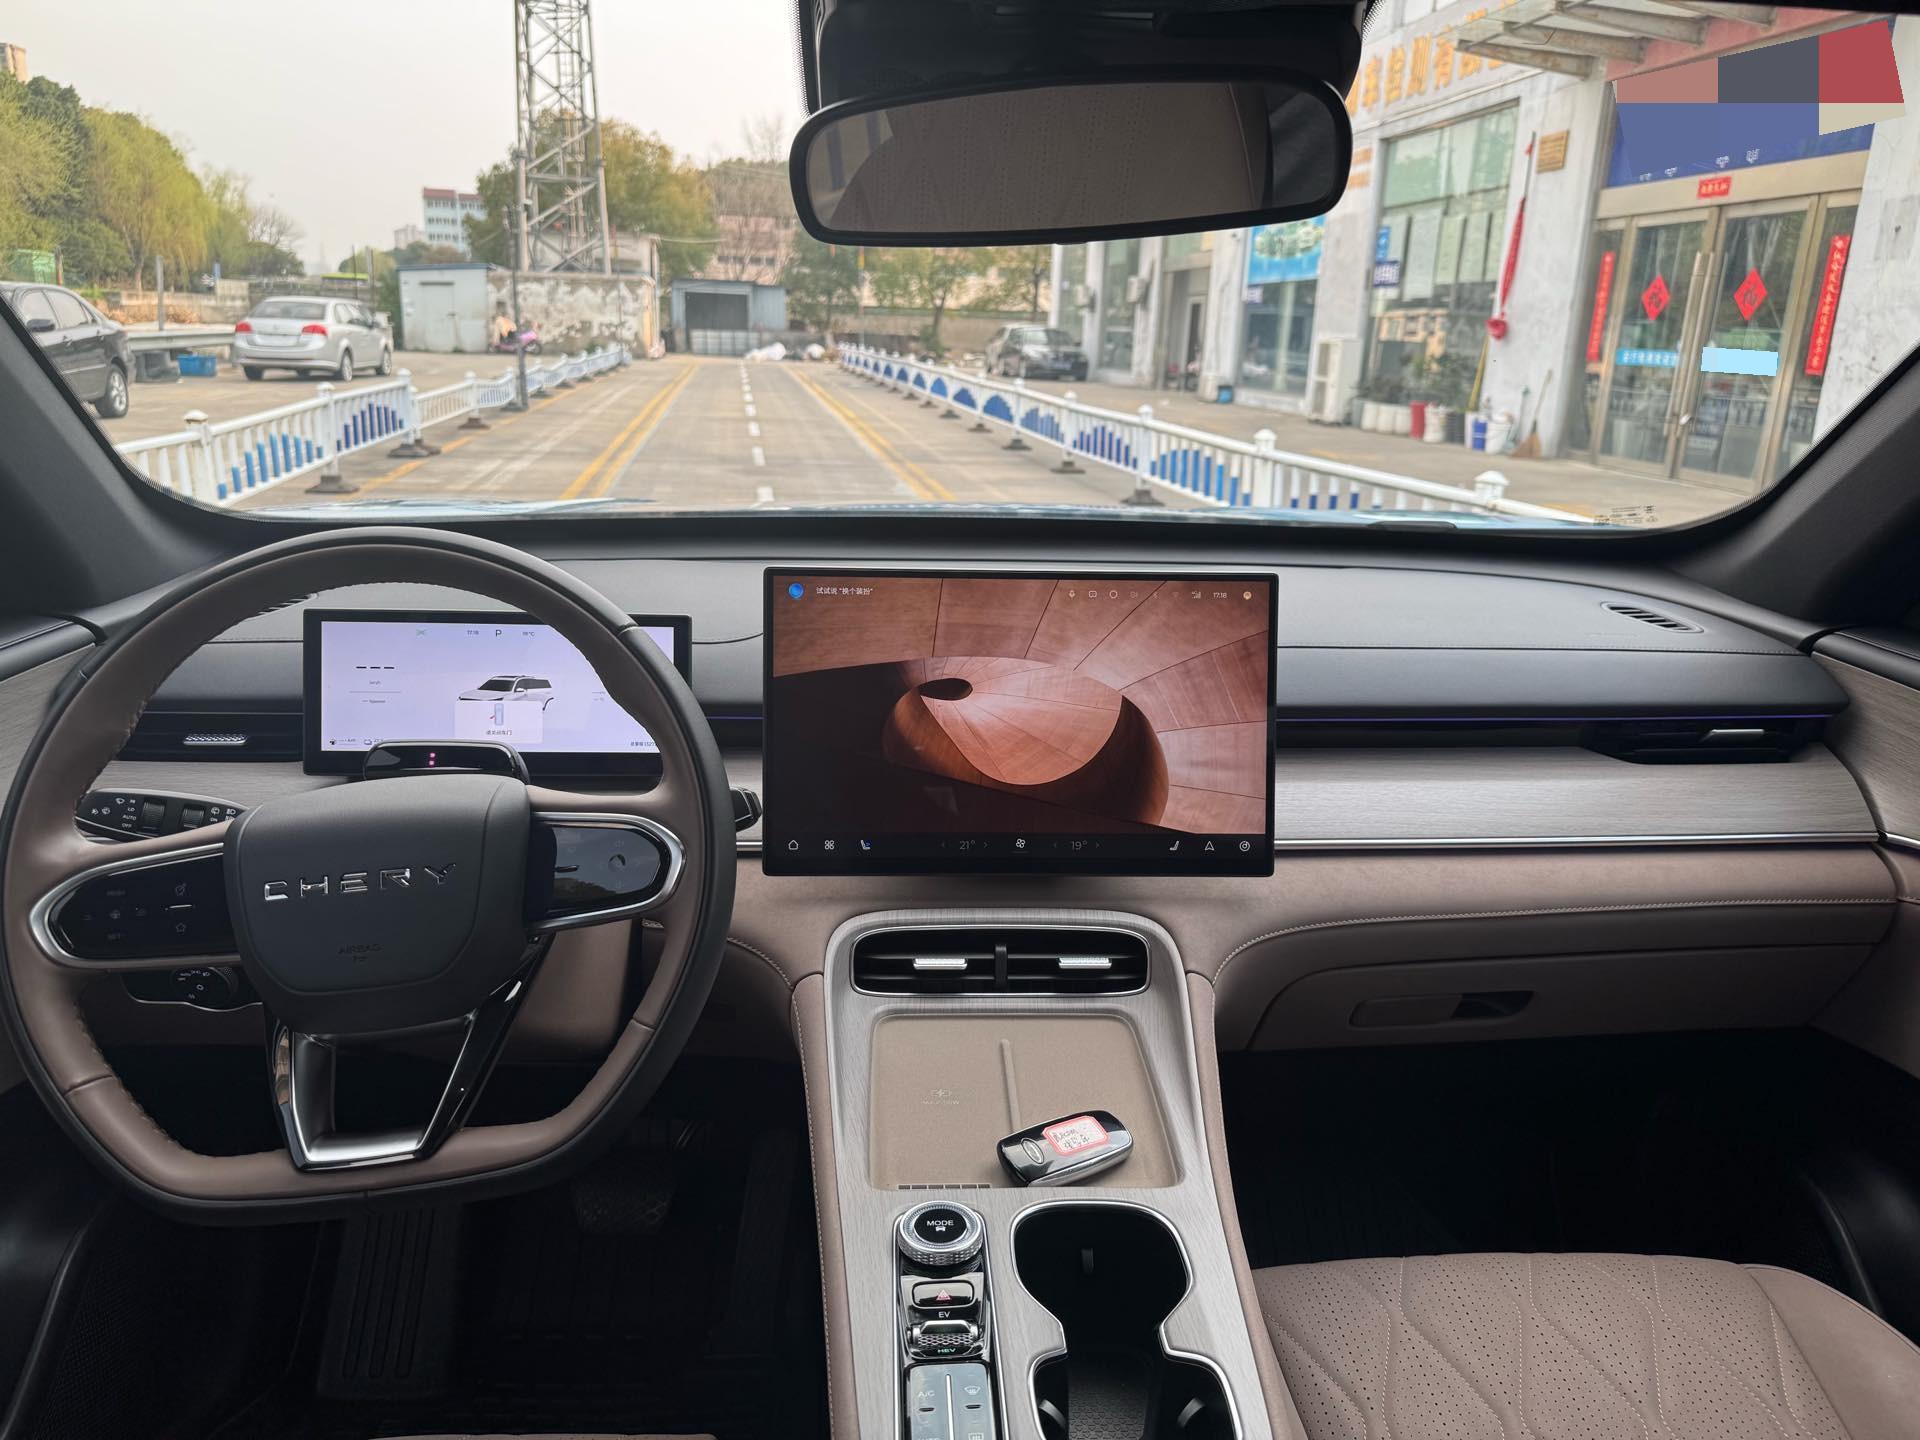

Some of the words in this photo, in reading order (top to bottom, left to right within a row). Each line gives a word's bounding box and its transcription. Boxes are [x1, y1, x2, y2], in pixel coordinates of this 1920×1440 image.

[495, 629, 502, 637] P
[264, 863, 457, 901] CHERY
[927, 1219, 955, 1227] MODE
[938, 1311, 950, 1319] EV
[918, 1389, 935, 1398] A/C
